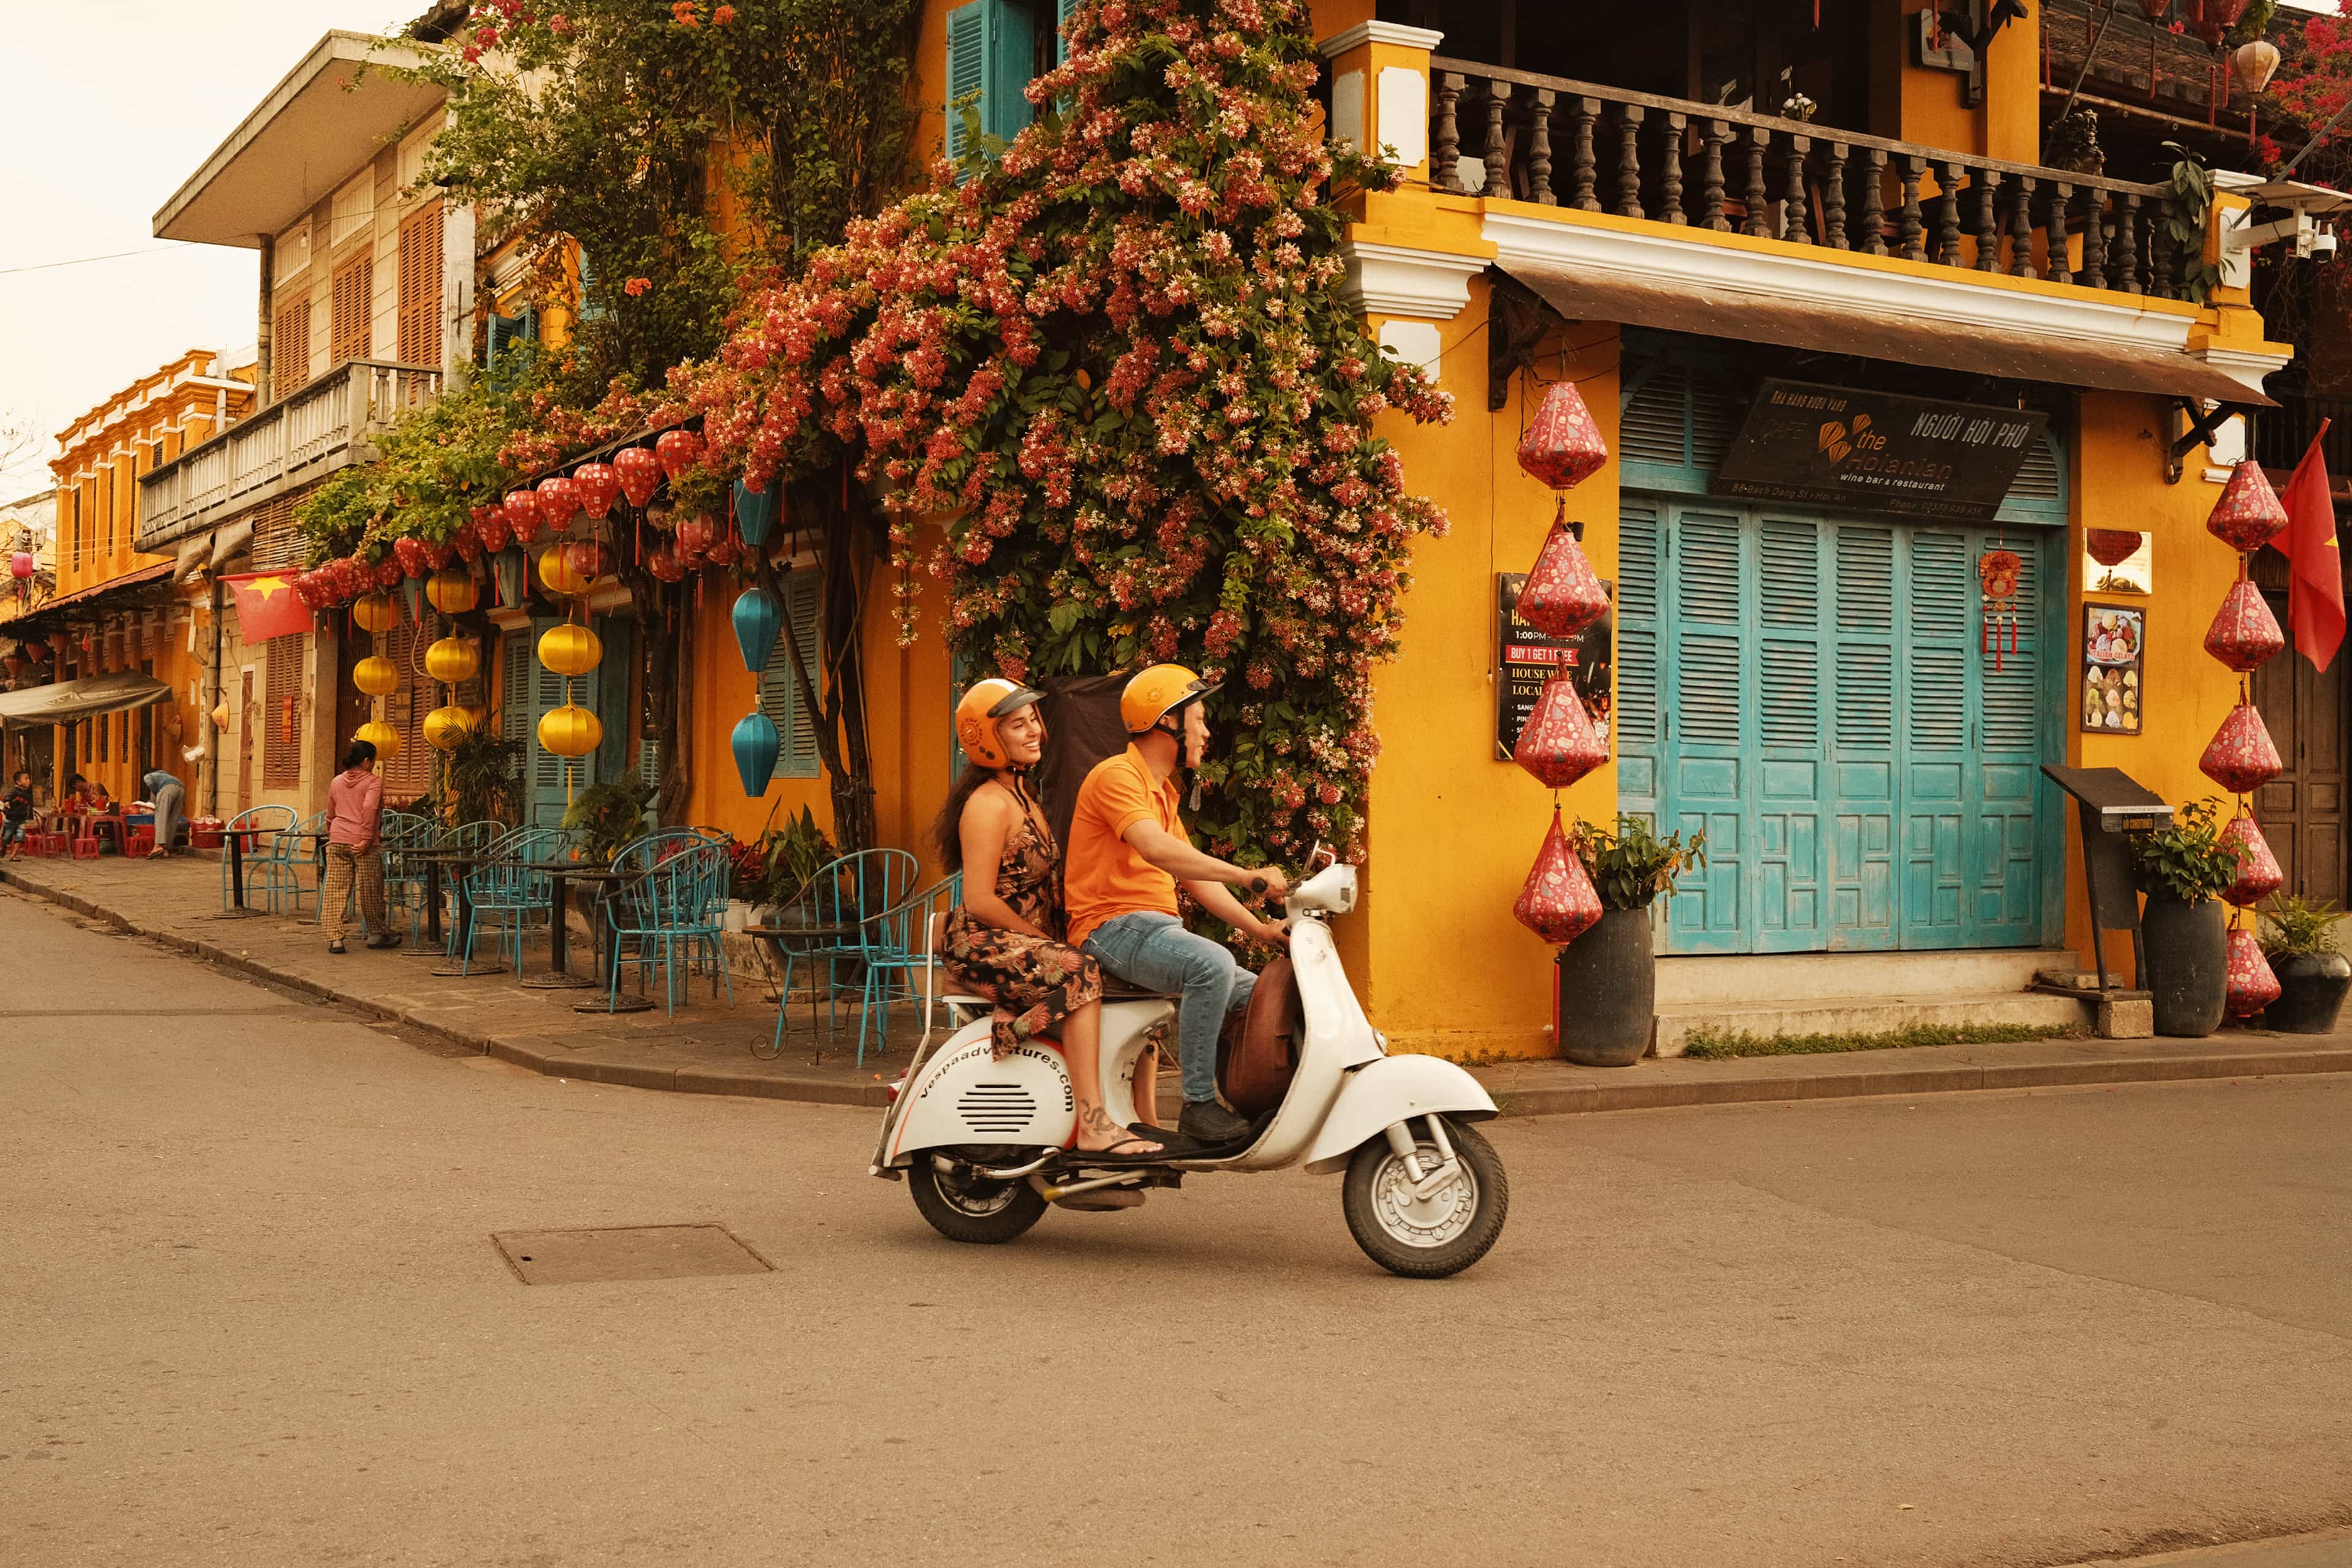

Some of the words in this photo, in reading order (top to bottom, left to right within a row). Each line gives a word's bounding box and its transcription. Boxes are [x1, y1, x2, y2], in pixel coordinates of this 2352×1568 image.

[1857, 430, 1887, 451] the
[1962, 417, 1996, 447] HỘI
[1845, 452, 1953, 480] Hoianian
[1840, 473, 1864, 483] wine
[1866, 475, 1884, 486] bar
[1892, 480, 1946, 491] restaurant
[1515, 631, 1547, 641] 1:00PM
[1511, 647, 1526, 658] BUY
[1527, 649, 1531, 658] 1
[1533, 649, 1547, 660] GET
[1548, 650, 1552, 660] 1
[1554, 650, 1573, 662] FEE
[1512, 668, 1545, 679] HOUSE
[1547, 669, 1573, 680] WIE
